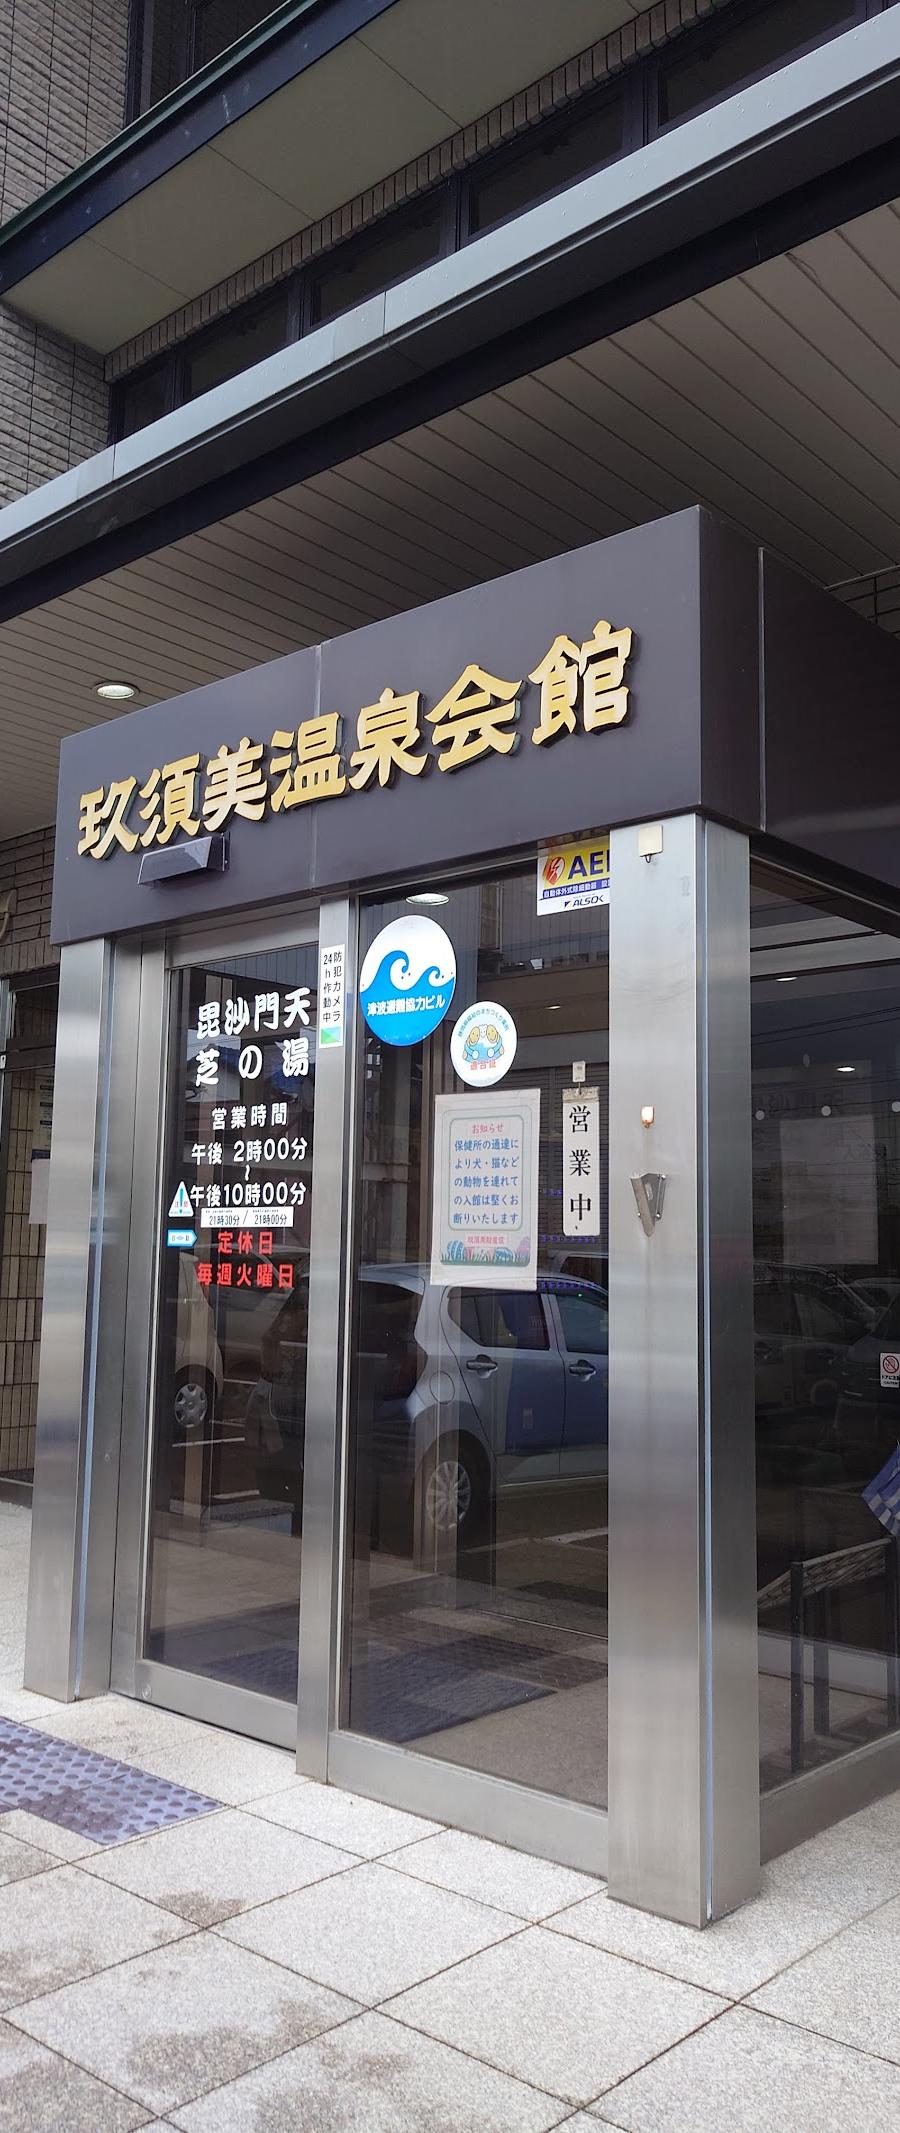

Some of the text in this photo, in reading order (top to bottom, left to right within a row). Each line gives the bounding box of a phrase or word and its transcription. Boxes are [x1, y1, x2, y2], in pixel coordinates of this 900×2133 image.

[77, 619, 635, 860] 玖須美温泉会館
[568, 849, 609, 880] AE
[573, 894, 604, 907] ALSOK
[333, 951, 342, 1022] 防犯カメラ
[196, 986, 311, 1040] 毘沙門天
[195, 1037, 309, 1087] 芝の湯
[211, 1102, 288, 1131] 営業時間
[472, 1123, 504, 1135] お知らせ
[191, 1137, 308, 1166] 午後 2時00分
[455, 1138, 519, 1151] 保健所の通達に
[569, 1105, 592, 1221] 営業中
[190, 1181, 307, 1208] 午後10時00分
[454, 1176, 519, 1188] の動物を連れて
[453, 1212, 518, 1225] 断りいたします
[217, 1230, 273, 1256] 定休日
[197, 1264, 294, 1289] 毎週火曜日
